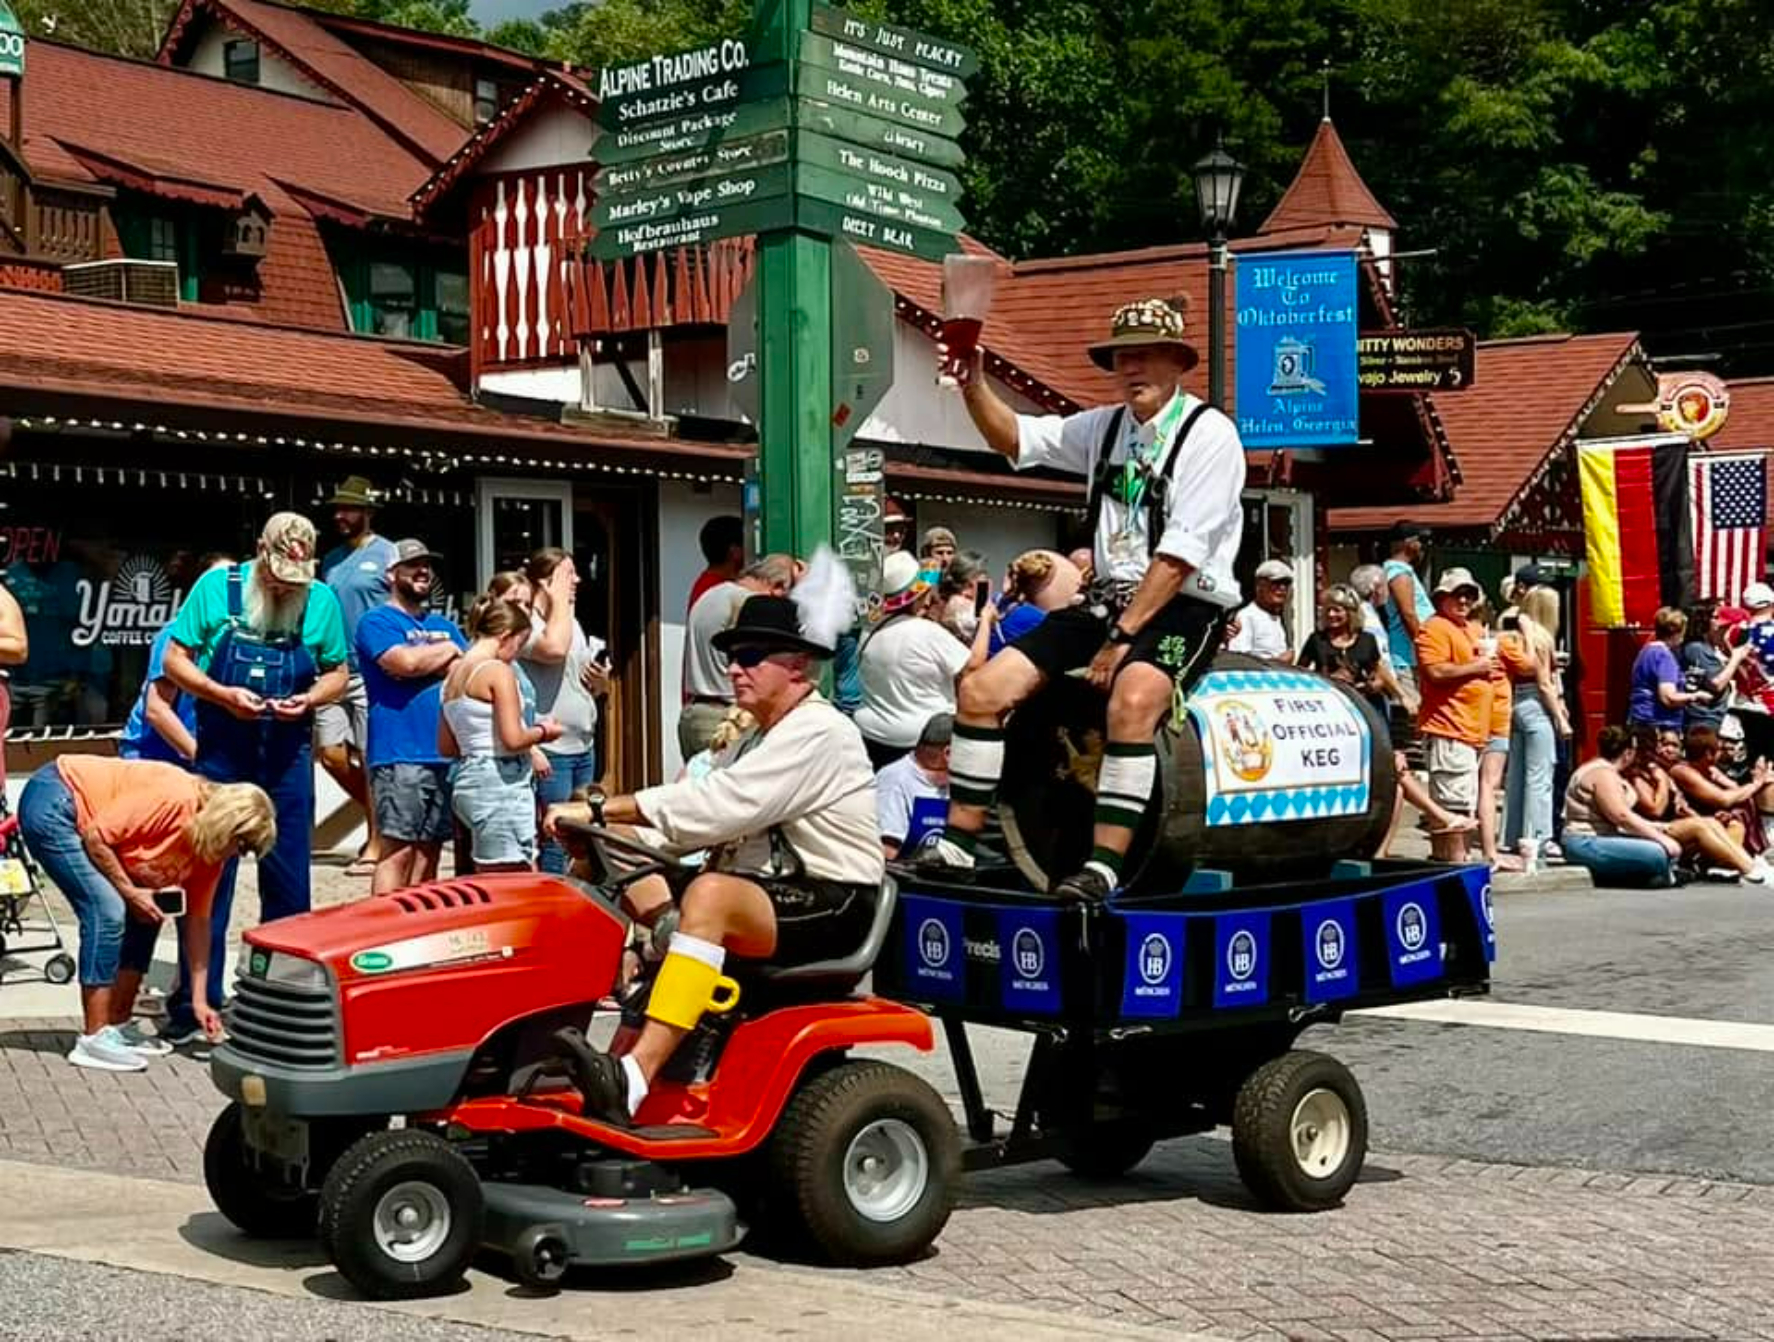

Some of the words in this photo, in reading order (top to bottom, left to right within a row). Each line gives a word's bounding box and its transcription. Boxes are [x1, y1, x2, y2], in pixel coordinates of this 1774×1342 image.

[875, 27, 905, 50] JUST
[600, 62, 650, 98] ALPINE
[652, 48, 718, 86] TRADING
[618, 90, 696, 120] Schatzie's
[702, 80, 739, 102] Cafe
[827, 80, 862, 104] Helen
[867, 94, 896, 113] Arts
[901, 102, 943, 126] Center
[618, 128, 676, 148] Discount
[681, 112, 738, 134] Package
[839, 149, 864, 170] The
[869, 158, 908, 184] Hooch
[914, 170, 947, 193] Pizza
[609, 195, 670, 220] Marley's
[677, 186, 712, 206] Vape
[718, 178, 756, 198] Shop
[633, 230, 700, 252] Restaurant
[1253, 267, 1338, 290] Welcome
[1237, 304, 1353, 326] Oktoberfest
[1393, 335, 1464, 352] WONDERS
[1389, 369, 1442, 386] Jewelry
[1273, 698, 1327, 714] FIRST
[1272, 723, 1357, 741] OFFICIAL
[1301, 748, 1341, 768] KEG
